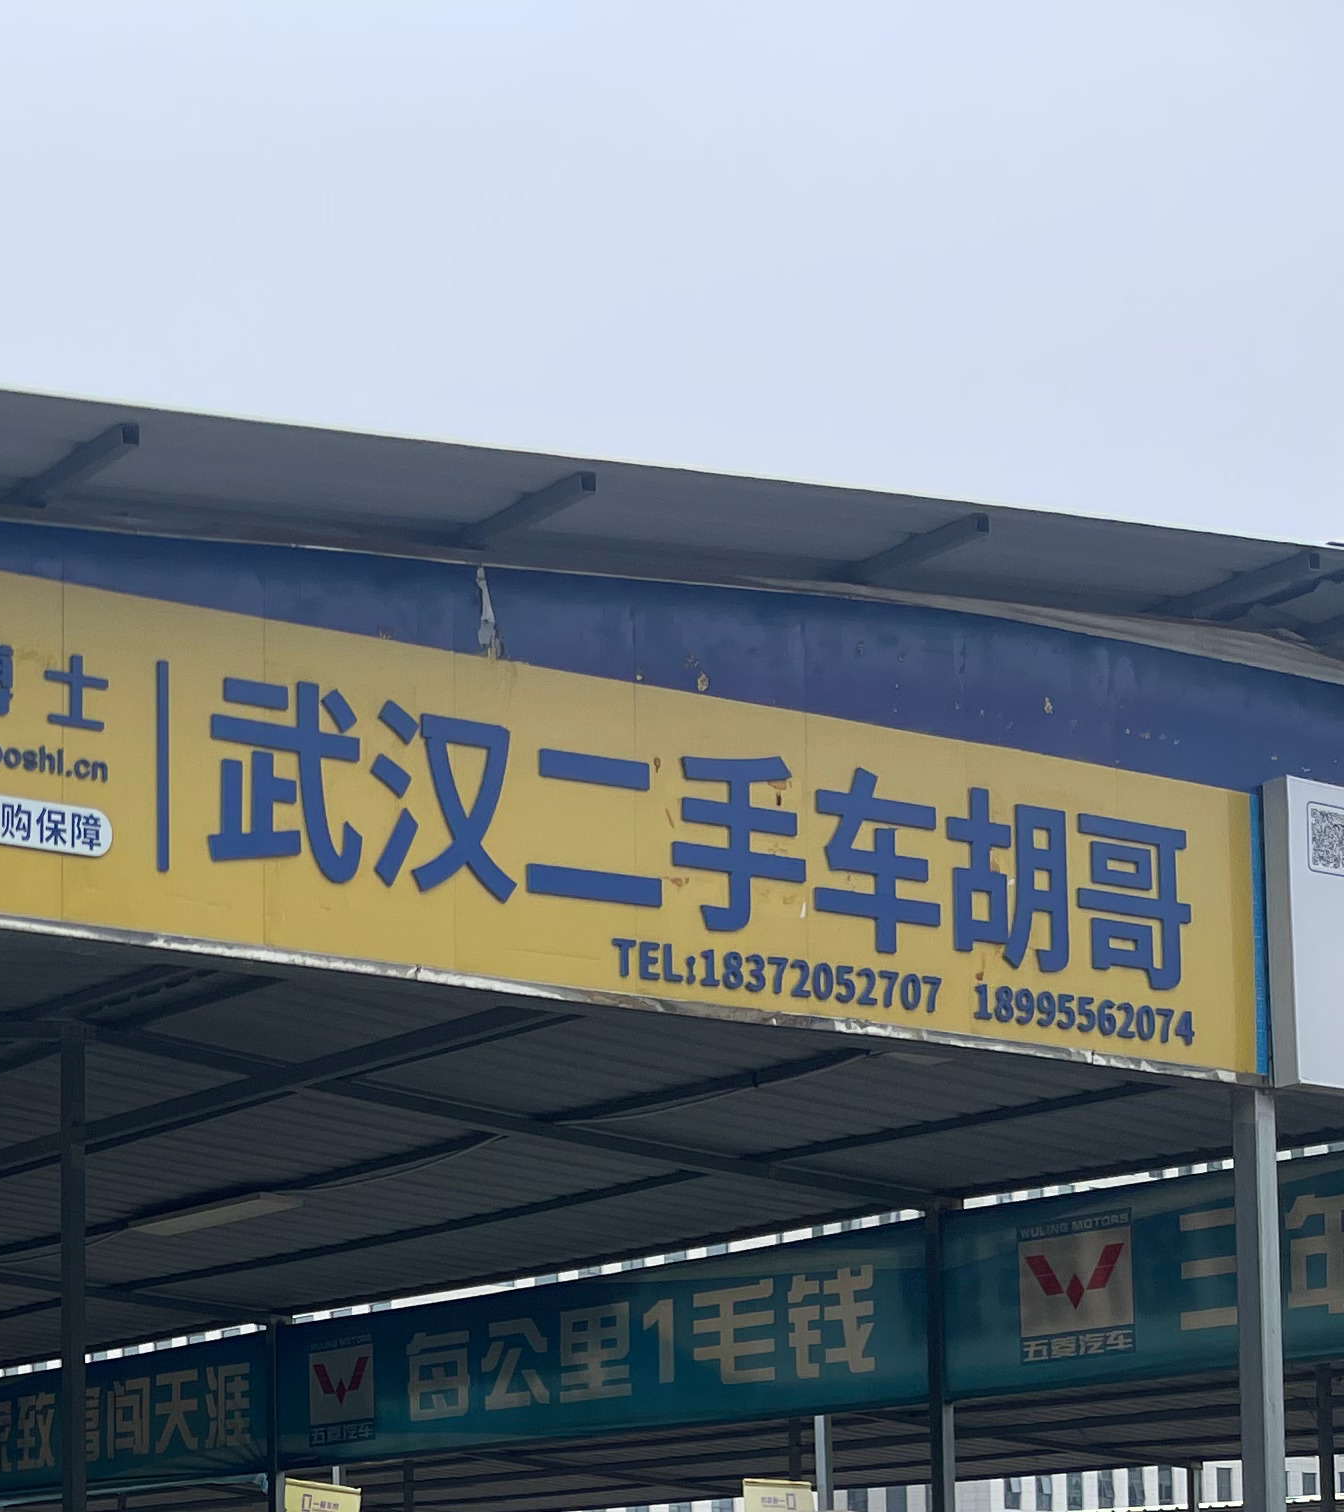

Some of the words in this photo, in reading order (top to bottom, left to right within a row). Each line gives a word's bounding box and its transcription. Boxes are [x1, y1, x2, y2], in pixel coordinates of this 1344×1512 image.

[208, 677, 1192, 991] 武汉二手车胡哥
[613, 938, 943, 1014] TEL:18372052707
[974, 983, 1196, 1046] 18995562074
[1071, 1212, 1129, 1230] MOTORS
[406, 1264, 876, 1422] 每公里1毛钱
[1023, 1330, 1133, 1362] 五菱汽车
